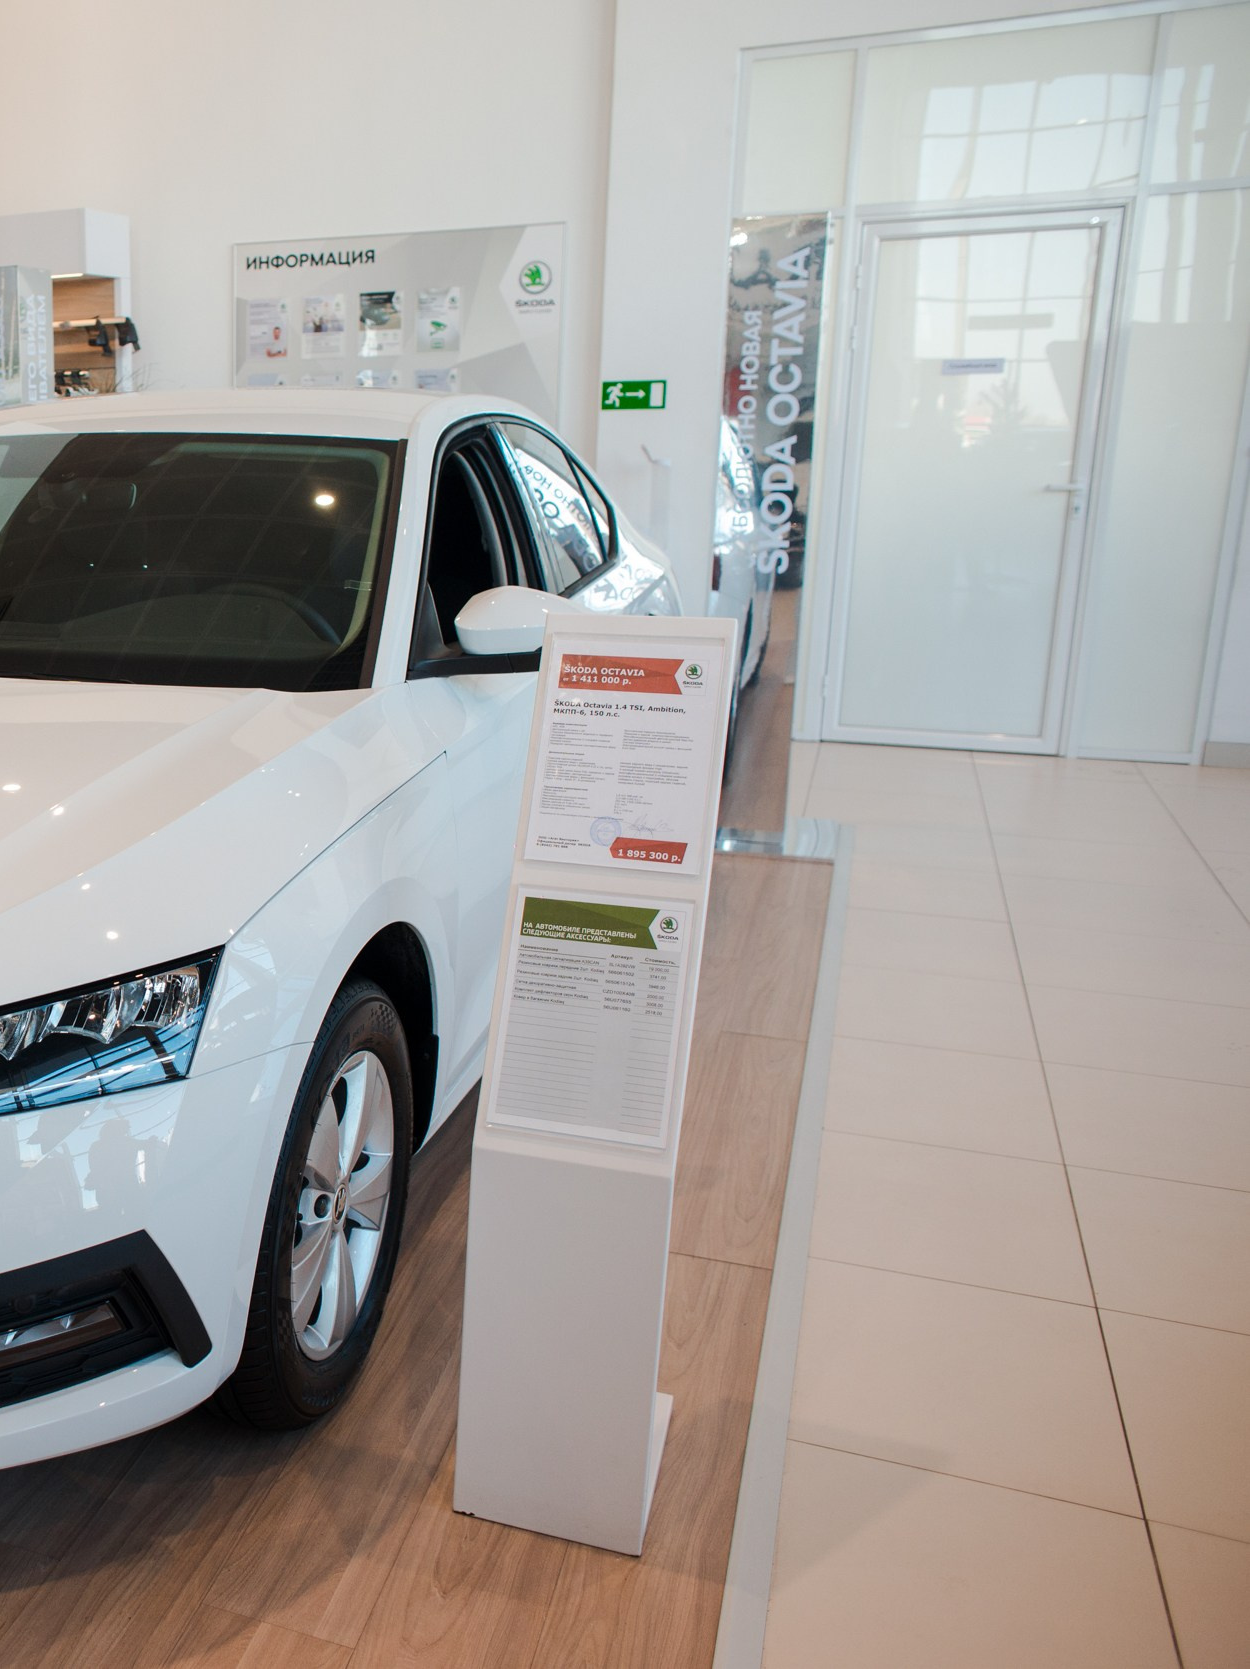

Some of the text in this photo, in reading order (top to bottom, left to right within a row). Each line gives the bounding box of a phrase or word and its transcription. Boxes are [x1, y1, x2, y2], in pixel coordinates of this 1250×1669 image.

[246, 248, 376, 271] ИНФОРМАЦИЯ
[765, 246, 811, 427] OCTAVIA
[38, 295, 48, 400] ВАТЕЛЕМ
[740, 310, 762, 391] НОВАЯ
[600, 666, 646, 677] OCTAVIA
[580, 675, 598, 683] 411
[601, 676, 620, 684] 000
[553, 708, 587, 717] МКПП-6,
[590, 709, 608, 717] 150
[583, 701, 613, 710] Octavia
[615, 703, 627, 711] 1.4
[630, 704, 645, 713] TSI,
[647, 705, 687, 715] Ambition,
[627, 849, 647, 859] 895
[648, 851, 669, 861] 300
[522, 928, 612, 943] СЛЕДУЮЩИЕ АКСЕССУАРЫ:
[523, 921, 637, 939] НА АВТОМОБИЛЕ ПРЕДСТАВЛЕНЫ
